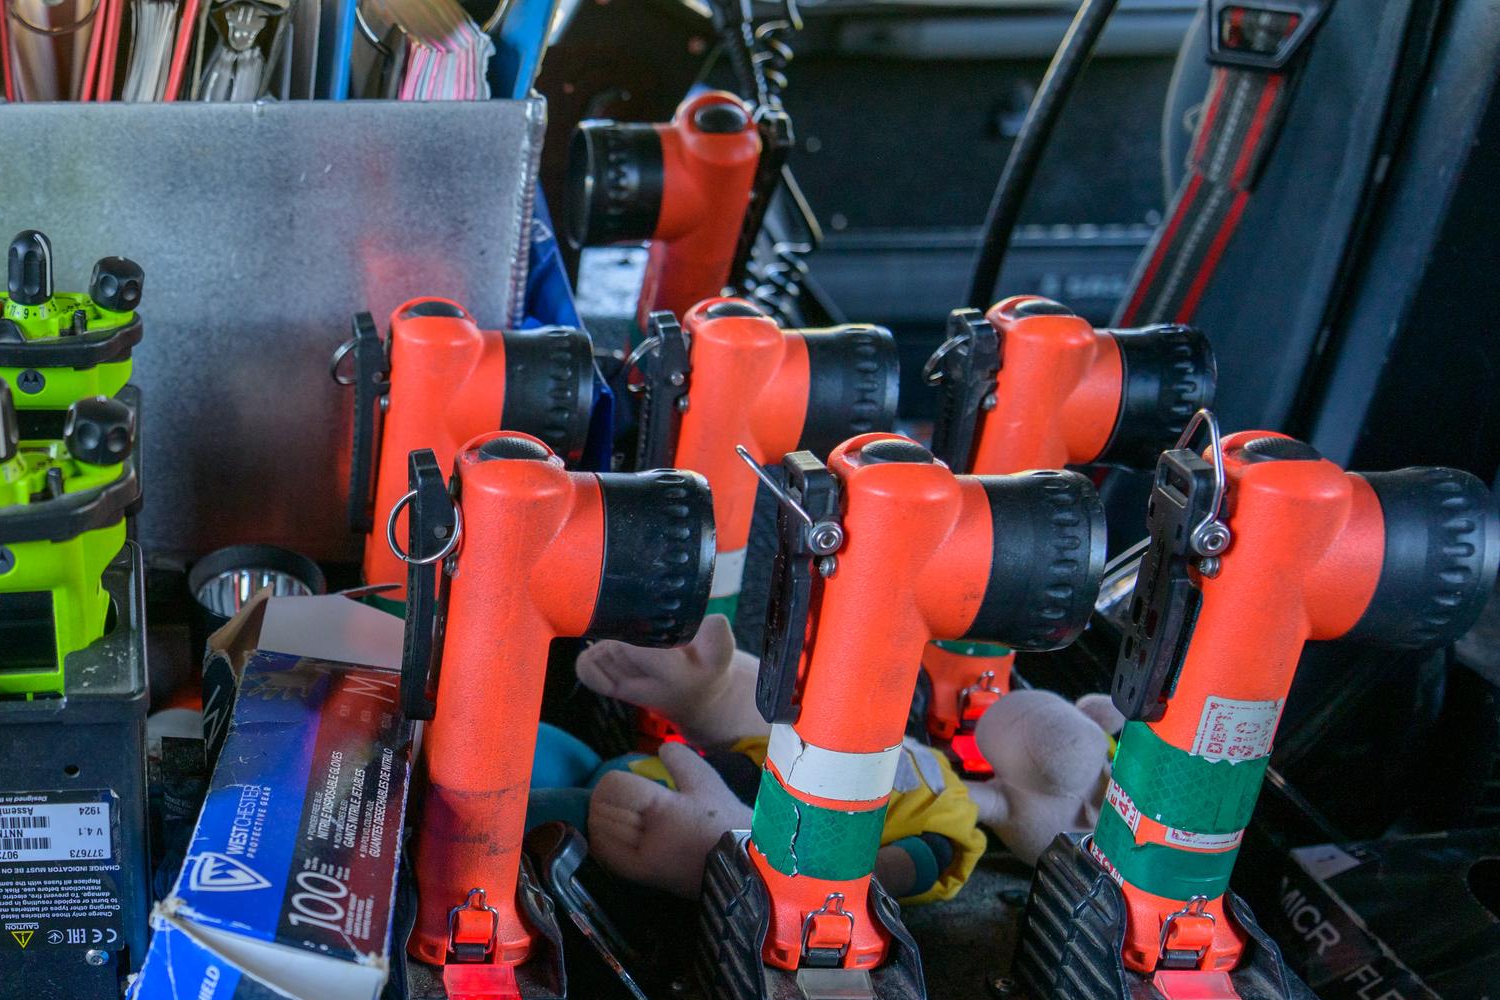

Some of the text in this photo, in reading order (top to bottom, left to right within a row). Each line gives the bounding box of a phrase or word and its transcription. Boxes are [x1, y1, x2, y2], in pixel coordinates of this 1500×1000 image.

[79, 806, 100, 814] 1924
[317, 751, 343, 840] NITRILE DISPOSABLE GLOVES
[343, 822, 357, 848] GANTS
[351, 769, 366, 799] JETABLES
[78, 828, 93, 836] 4.1
[97, 828, 103, 836] V
[226, 785, 261, 855] WESTCHESTER
[70, 849, 104, 857] 377673
[288, 871, 348, 932] 100
